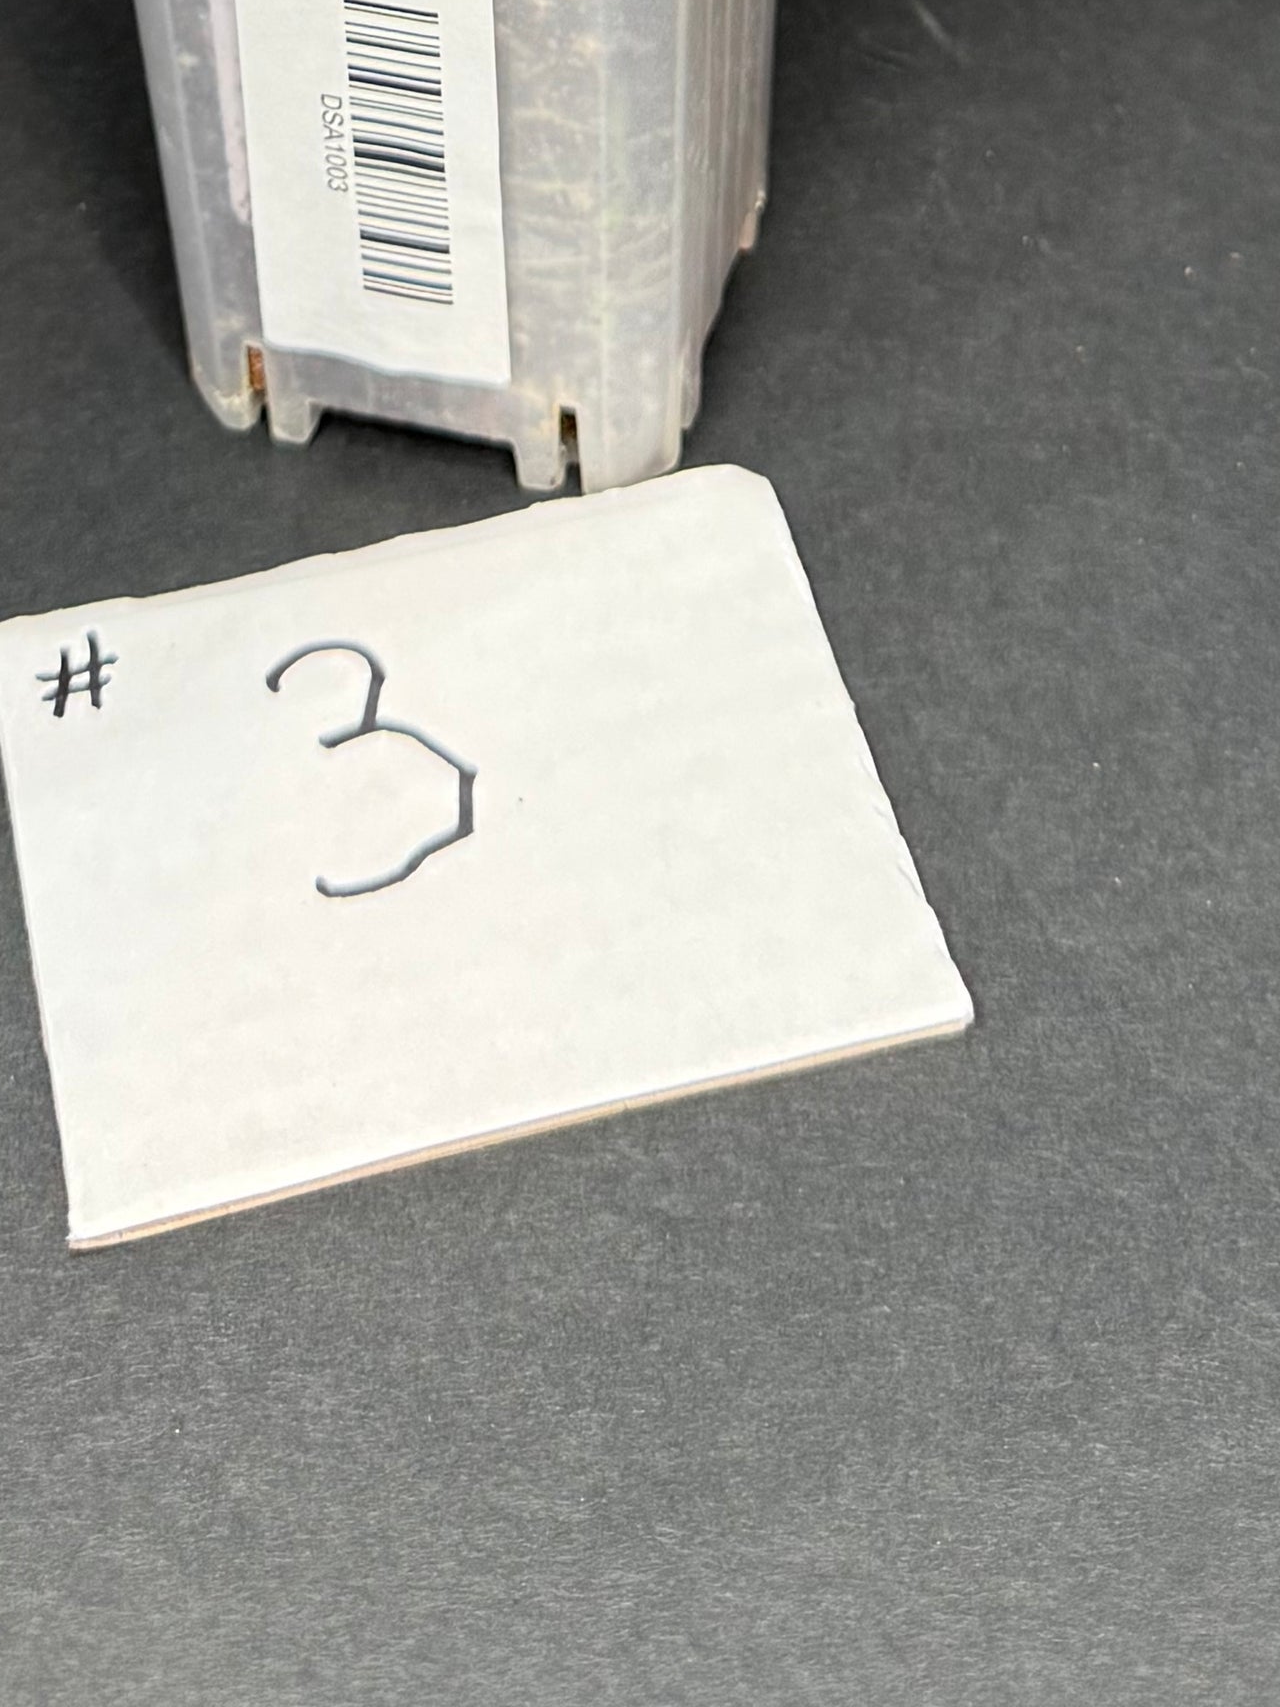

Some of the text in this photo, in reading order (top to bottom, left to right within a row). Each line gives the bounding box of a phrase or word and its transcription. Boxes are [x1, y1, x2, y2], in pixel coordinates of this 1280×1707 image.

[319, 93, 349, 193] DSA1003
[35, 630, 478, 898] # 3
